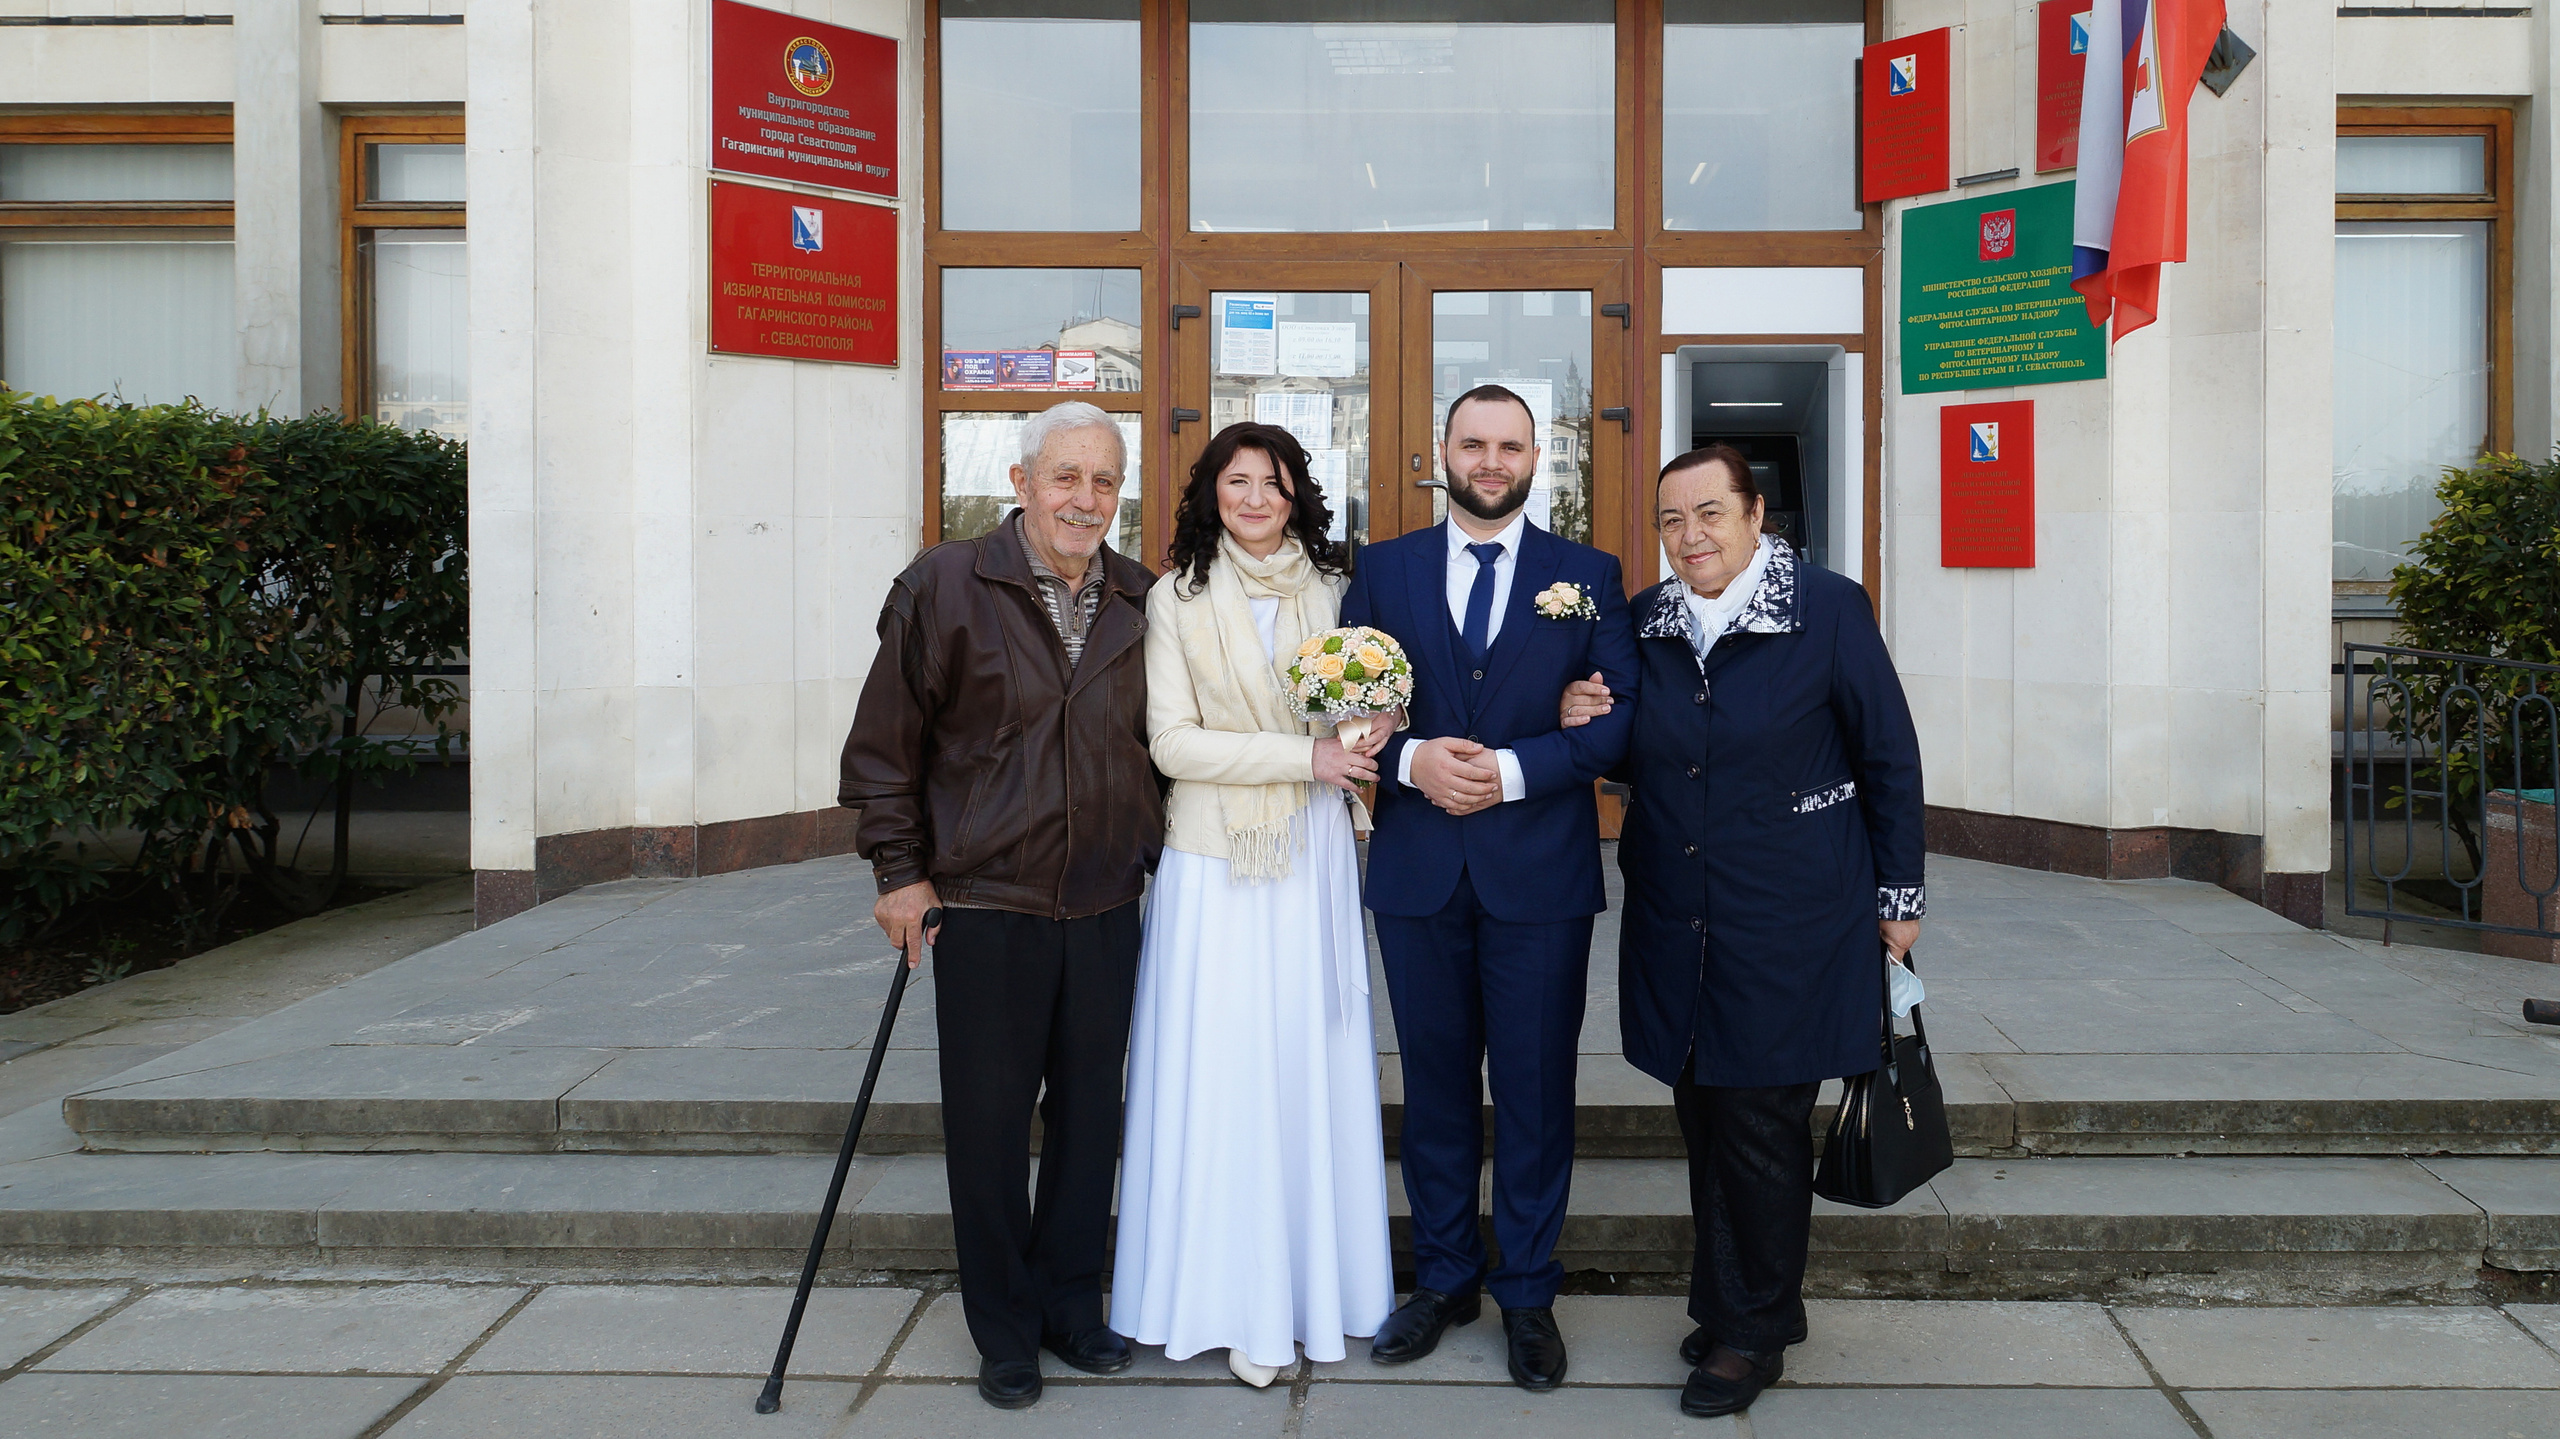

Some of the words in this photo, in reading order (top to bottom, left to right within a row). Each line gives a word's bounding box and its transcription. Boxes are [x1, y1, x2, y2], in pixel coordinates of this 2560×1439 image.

[767, 92, 850, 119] Внутригородское
[739, 106, 814, 129] муниципальное
[818, 120, 876, 141] образование
[760, 127, 794, 143] города
[798, 133, 856, 154] Севастополя
[722, 137, 784, 158] Гагаринский
[788, 149, 862, 172] муниципальный
[866, 165, 890, 178] округ
[751, 262, 861, 288] ТЕРРИТОРИАЛЬНАЯ
[1922, 278, 1981, 292] МИНИСТЕРСТВО
[1983, 272, 2028, 285] СЕЛЬСКОГО
[2030, 265, 2073, 278] ХОЗЯЙСТВ
[723, 281, 822, 305] ИЗБИРАТЕЛЬНАЯ
[827, 293, 886, 312] КОМИССИЯ
[1947, 284, 1998, 299] РОССИЙСКОЙ
[2000, 279, 2050, 293] ФЕДЕРАЦИИ
[738, 305, 827, 327] ГАГАРИНСКОГО
[830, 314, 874, 332] РАЙОНА
[1908, 309, 1963, 324] ФЕДЕРАЛЬНАЯ
[1965, 306, 1999, 317] СЛУЖБА
[2002, 304, 2013, 312] ПО
[2015, 296, 2086, 311] ВЕТЕРИНАРНОМУ
[1939, 314, 2019, 329] ФИТОСАНИТАРНОМУ
[2021, 309, 2060, 321] НАДЗОРУ
[760, 333, 768, 343] г.
[771, 331, 854, 350] СЕВАСТОПОЛЯ
[1924, 338, 1976, 351] УПРАВЛЕНИЕ
[1977, 331, 2036, 346] ФЕДЕРАЛЬНОЙ
[2038, 328, 2077, 339] СЛУЖБЫ
[1954, 350, 1965, 358] ПО
[1967, 344, 2033, 358] ВЕТЕРИНАРНОМУ
[2038, 342, 2044, 350] И
[1931, 368, 1980, 380] РЕСПУБЛИКЕ
[1983, 366, 2006, 375] КРЫМ
[2017, 364, 2023, 372] Г.
[2026, 359, 2085, 371] СЕВАСТОПОЛЬ
[1939, 356, 2020, 370] ФИТОСАНИТАРНОМУ
[2022, 351, 2060, 362] НАДЗОРУ
